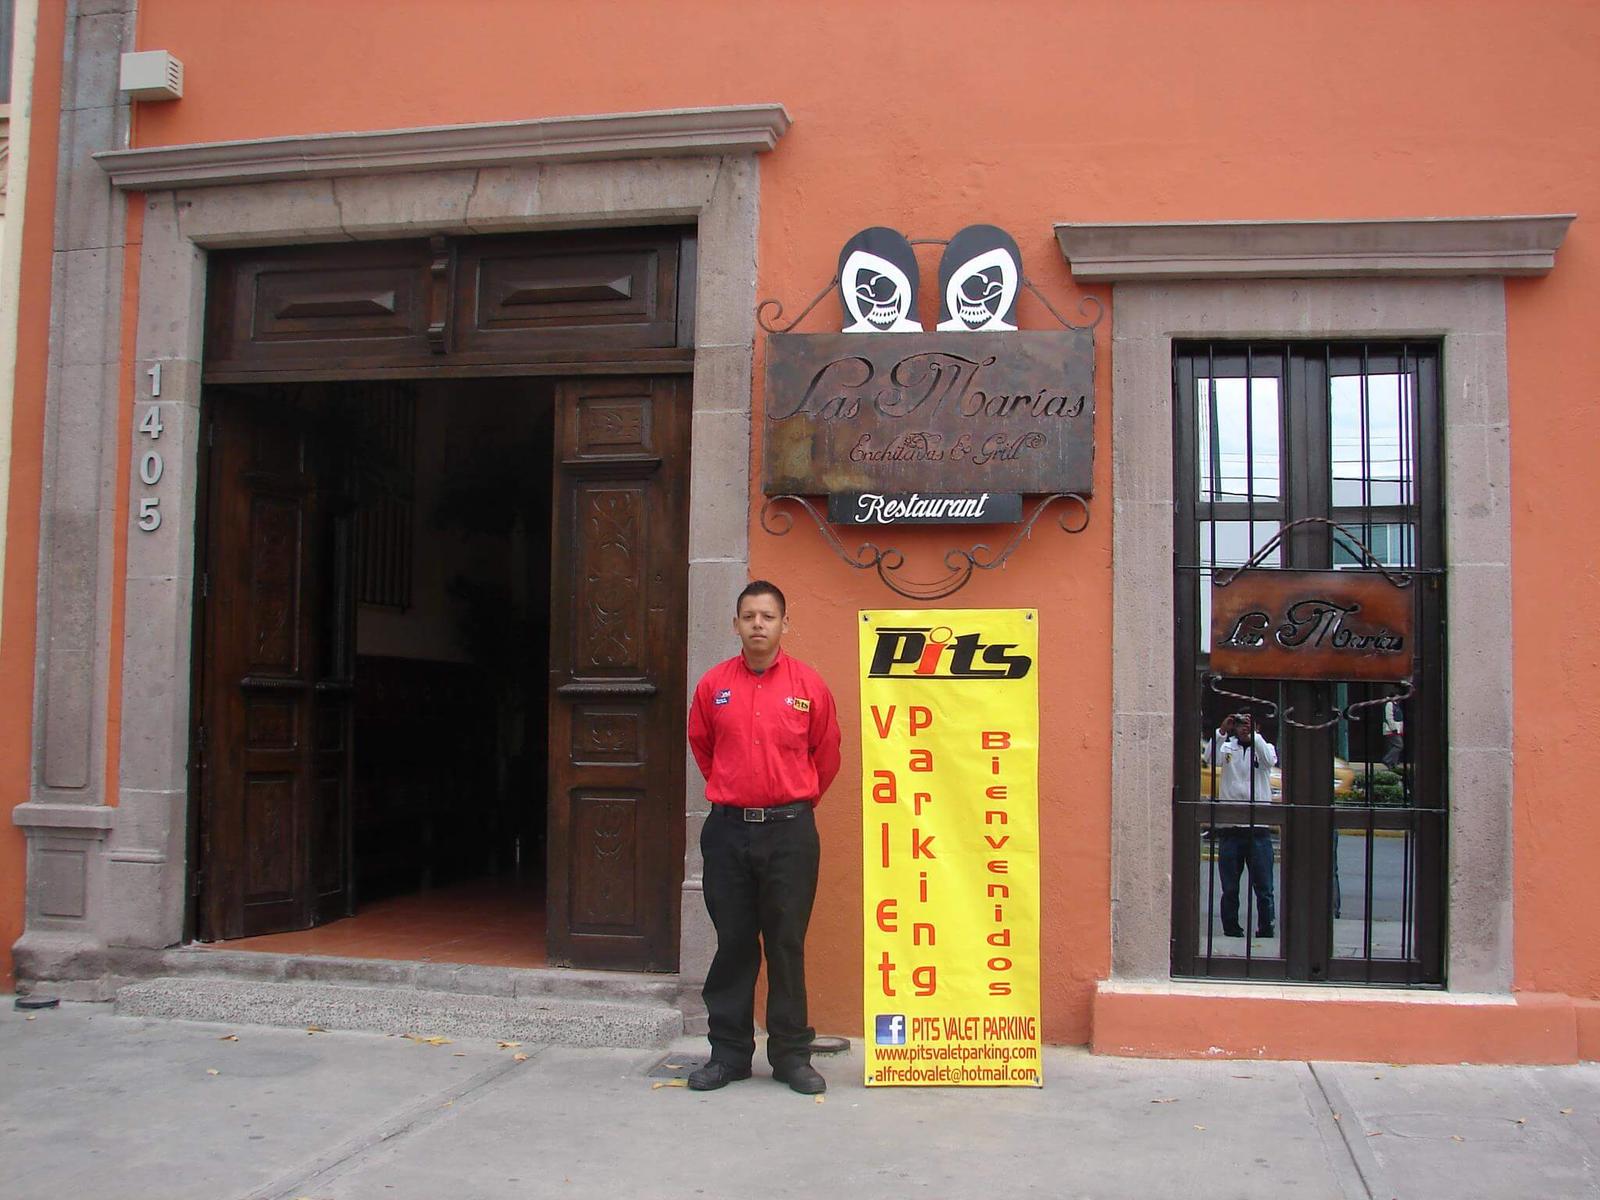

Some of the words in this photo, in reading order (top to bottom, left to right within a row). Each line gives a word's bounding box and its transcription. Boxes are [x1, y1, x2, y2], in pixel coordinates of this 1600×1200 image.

[768, 356, 875, 421] Las
[875, 352, 1086, 419] Marías
[138, 363, 164, 532] 1405
[972, 431, 1047, 466] Grill
[855, 493, 990, 524] Restaurant
[868, 626, 1032, 680] Pits
[909, 705, 937, 997] Parking
[981, 731, 1013, 996] Bienvenidos
[912, 1017, 941, 1041] PITS
[943, 1017, 980, 1041] VALET
[983, 1016, 1036, 1041] PARKING
[875, 1044, 1037, 1063] www.pitsvaletparking.com
[875, 1065, 1037, 1083] alfredovalet@hotmail.com
